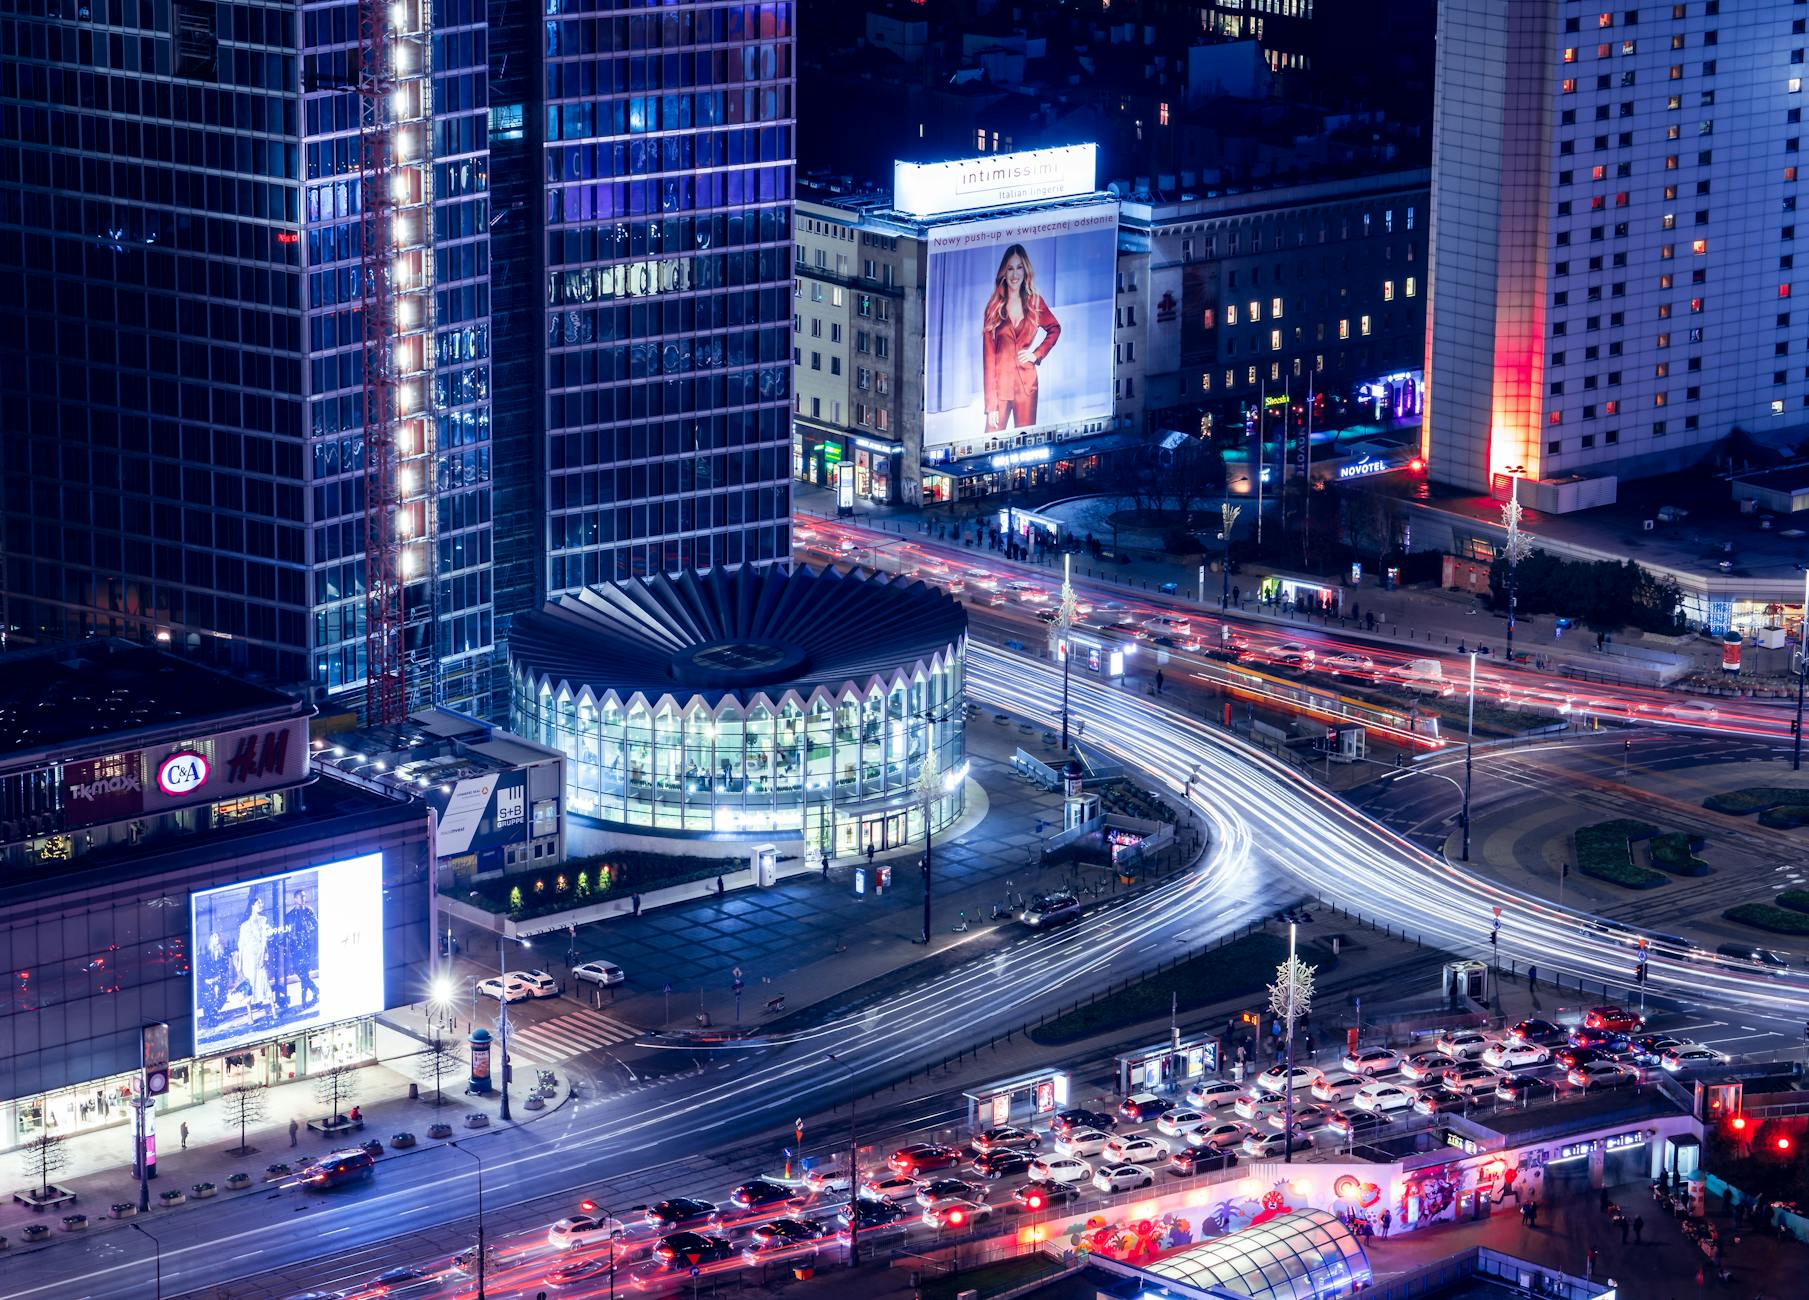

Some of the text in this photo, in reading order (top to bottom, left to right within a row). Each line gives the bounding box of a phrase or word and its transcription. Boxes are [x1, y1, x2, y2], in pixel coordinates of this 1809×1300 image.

[963, 163, 1058, 184] intimissimi
[1000, 184, 1065, 200] Italian lingerie
[934, 236, 961, 248] Nowy
[965, 231, 1002, 245] push-up
[1017, 222, 1071, 235] świątecznej
[1074, 214, 1113, 227] odsłonie
[1296, 427, 1305, 480] NOVOTE
[1341, 460, 1385, 477] NOVOTEL
[227, 728, 290, 784] H&M
[167, 761, 200, 785] C&A
[500, 806, 522, 818] S+B
[497, 818, 524, 828] GRUPPE
